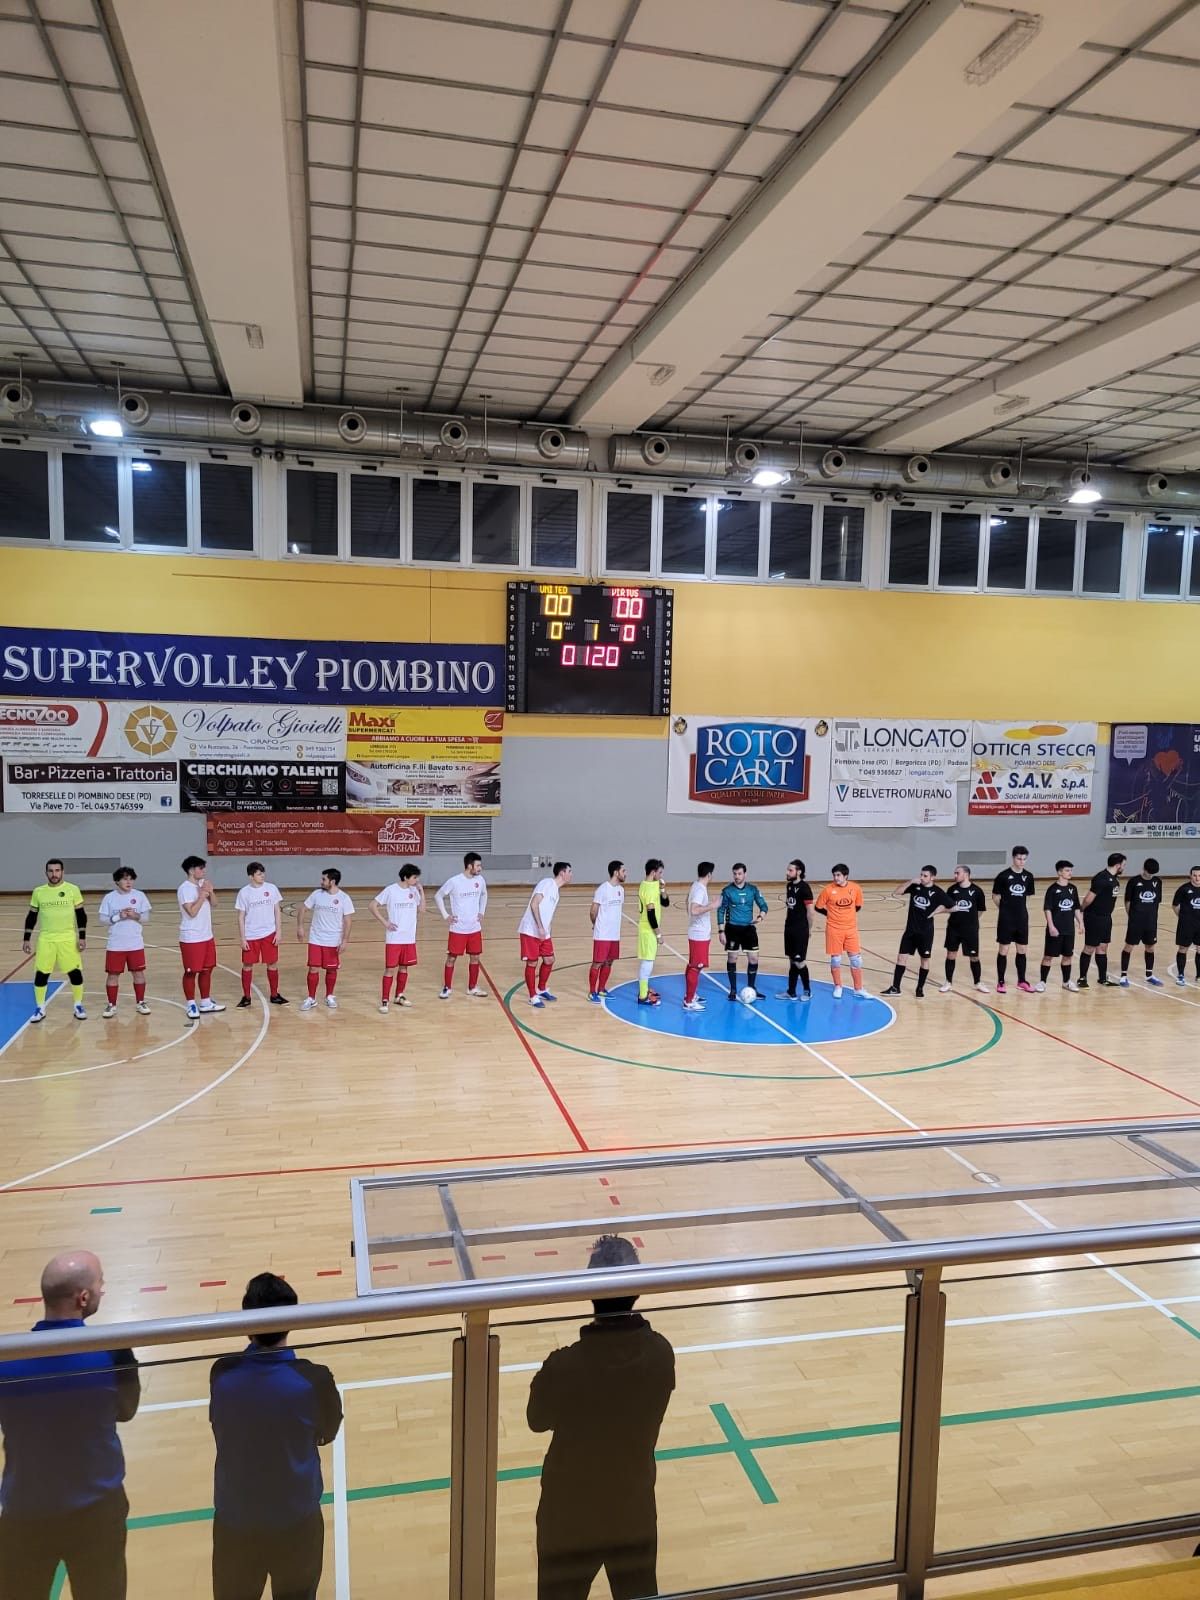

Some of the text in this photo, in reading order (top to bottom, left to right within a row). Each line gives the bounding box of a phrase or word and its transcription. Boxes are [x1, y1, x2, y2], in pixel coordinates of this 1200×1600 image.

[539, 585, 568, 594] UNITED
[611, 588, 639, 598] VIRTUS
[544, 594, 572, 616] 00
[616, 598, 643, 619] 00
[550, 622, 562, 639] 0
[623, 624, 635, 641] 0
[2, 646, 496, 694] SUPERVOLLEY PIOMBINO
[183, 707, 343, 738] Volpato Gioielli
[350, 712, 396, 727] Maxi
[705, 728, 797, 757] ROTO
[864, 728, 966, 747] LONGATO
[973, 743, 1096, 756] OTTICA STECCA
[15, 766, 173, 780] Bar Pizzeria Trattoria
[187, 764, 338, 776] CERCHIAMO TALENTI
[704, 759, 794, 786] CART
[1008, 773, 1088, 790] S.A.V. S.p.A.
[137, 792, 152, 800] (PD)
[852, 789, 952, 798] BELVETROMURANO
[217, 840, 246, 848] Agenzia
[378, 844, 419, 852] GENERALI
